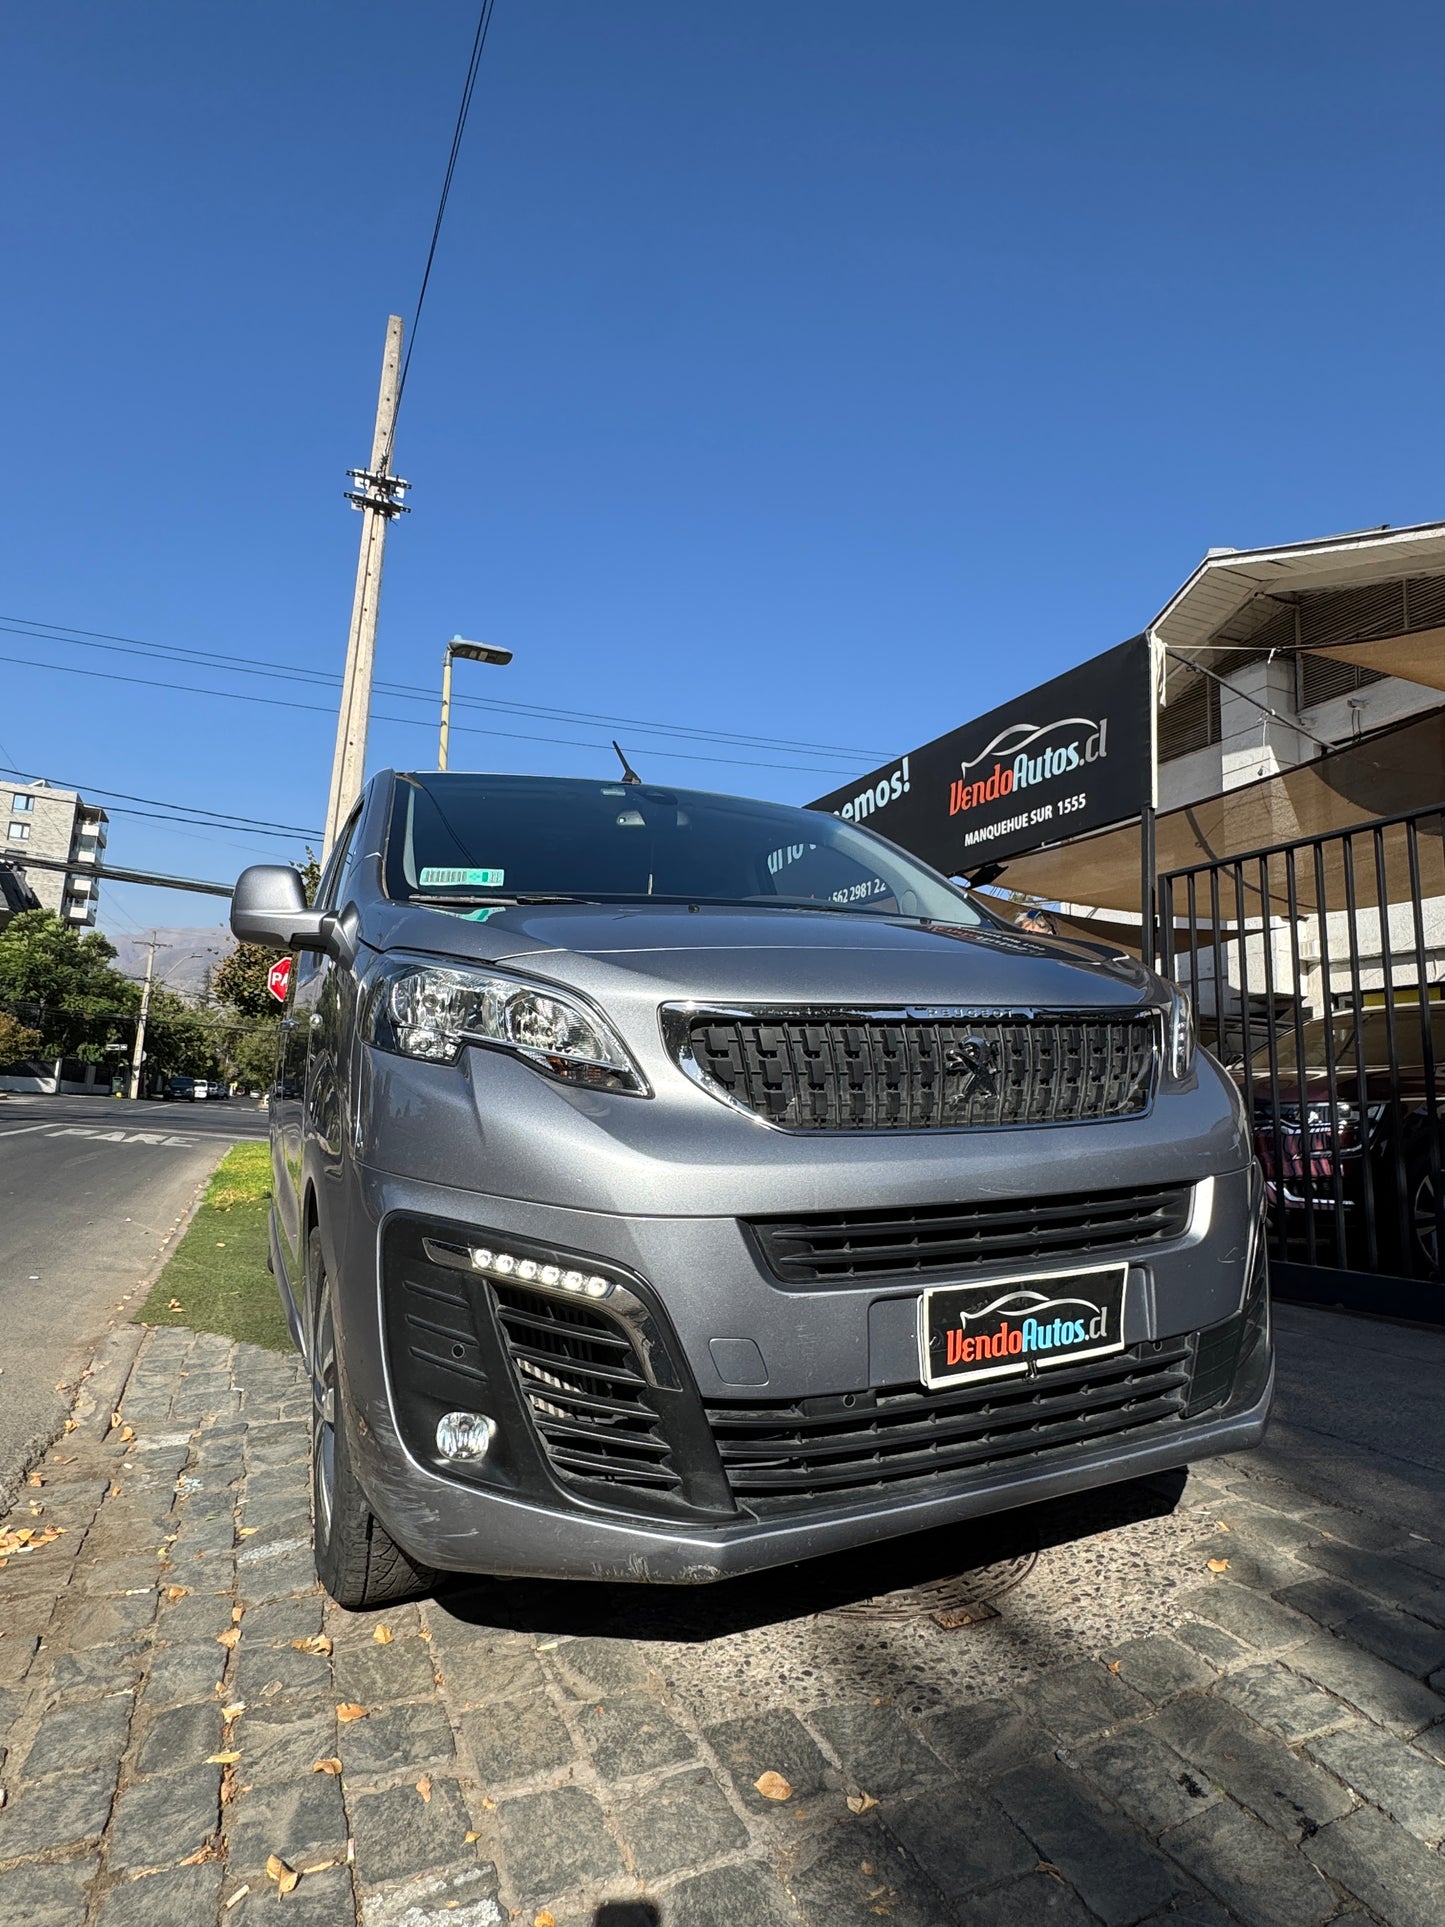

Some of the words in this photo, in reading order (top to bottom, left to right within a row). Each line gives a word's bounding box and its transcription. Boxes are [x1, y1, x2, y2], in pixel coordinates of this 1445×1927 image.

[832, 756, 911, 823] emos!
[949, 718, 1108, 817] VendoAutos.cl
[964, 813, 1029, 847] MANQUEHUE
[1030, 805, 1053, 825] SUR
[1057, 793, 1087, 816] 1555
[849, 880, 872, 901] 2981
[927, 1008, 1013, 1018] PEUGEOT
[45, 1128, 200, 1148] PARE
[946, 1306, 1108, 1366] VendoAutos.cl
